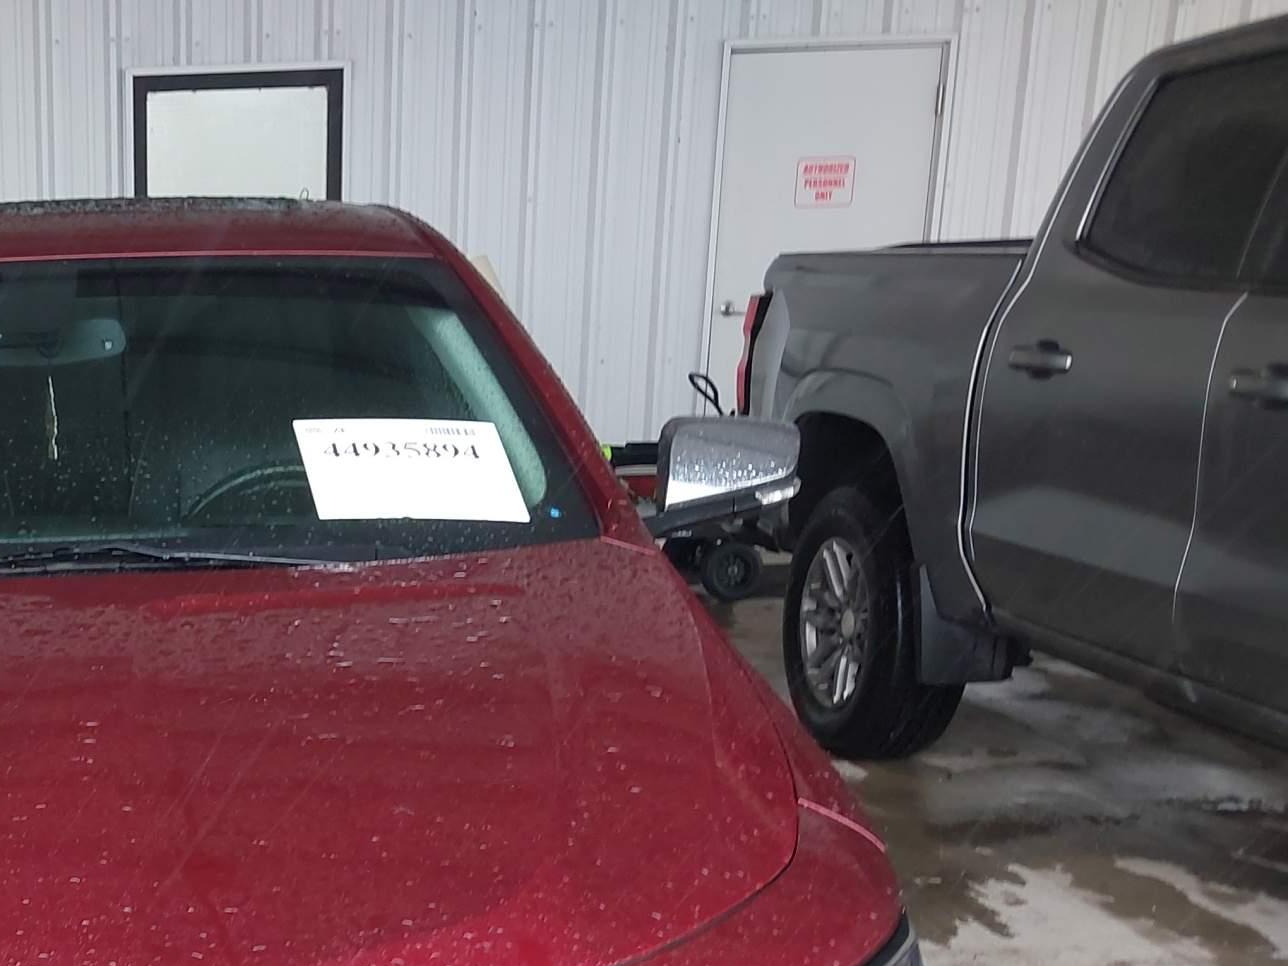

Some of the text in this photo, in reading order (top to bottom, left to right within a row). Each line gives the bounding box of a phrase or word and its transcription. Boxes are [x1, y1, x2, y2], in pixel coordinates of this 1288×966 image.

[803, 163, 850, 175] AUTHORIZED
[804, 178, 845, 189] PERSONNEL
[814, 191, 833, 200] ONLY
[324, 440, 480, 459] 44935894
